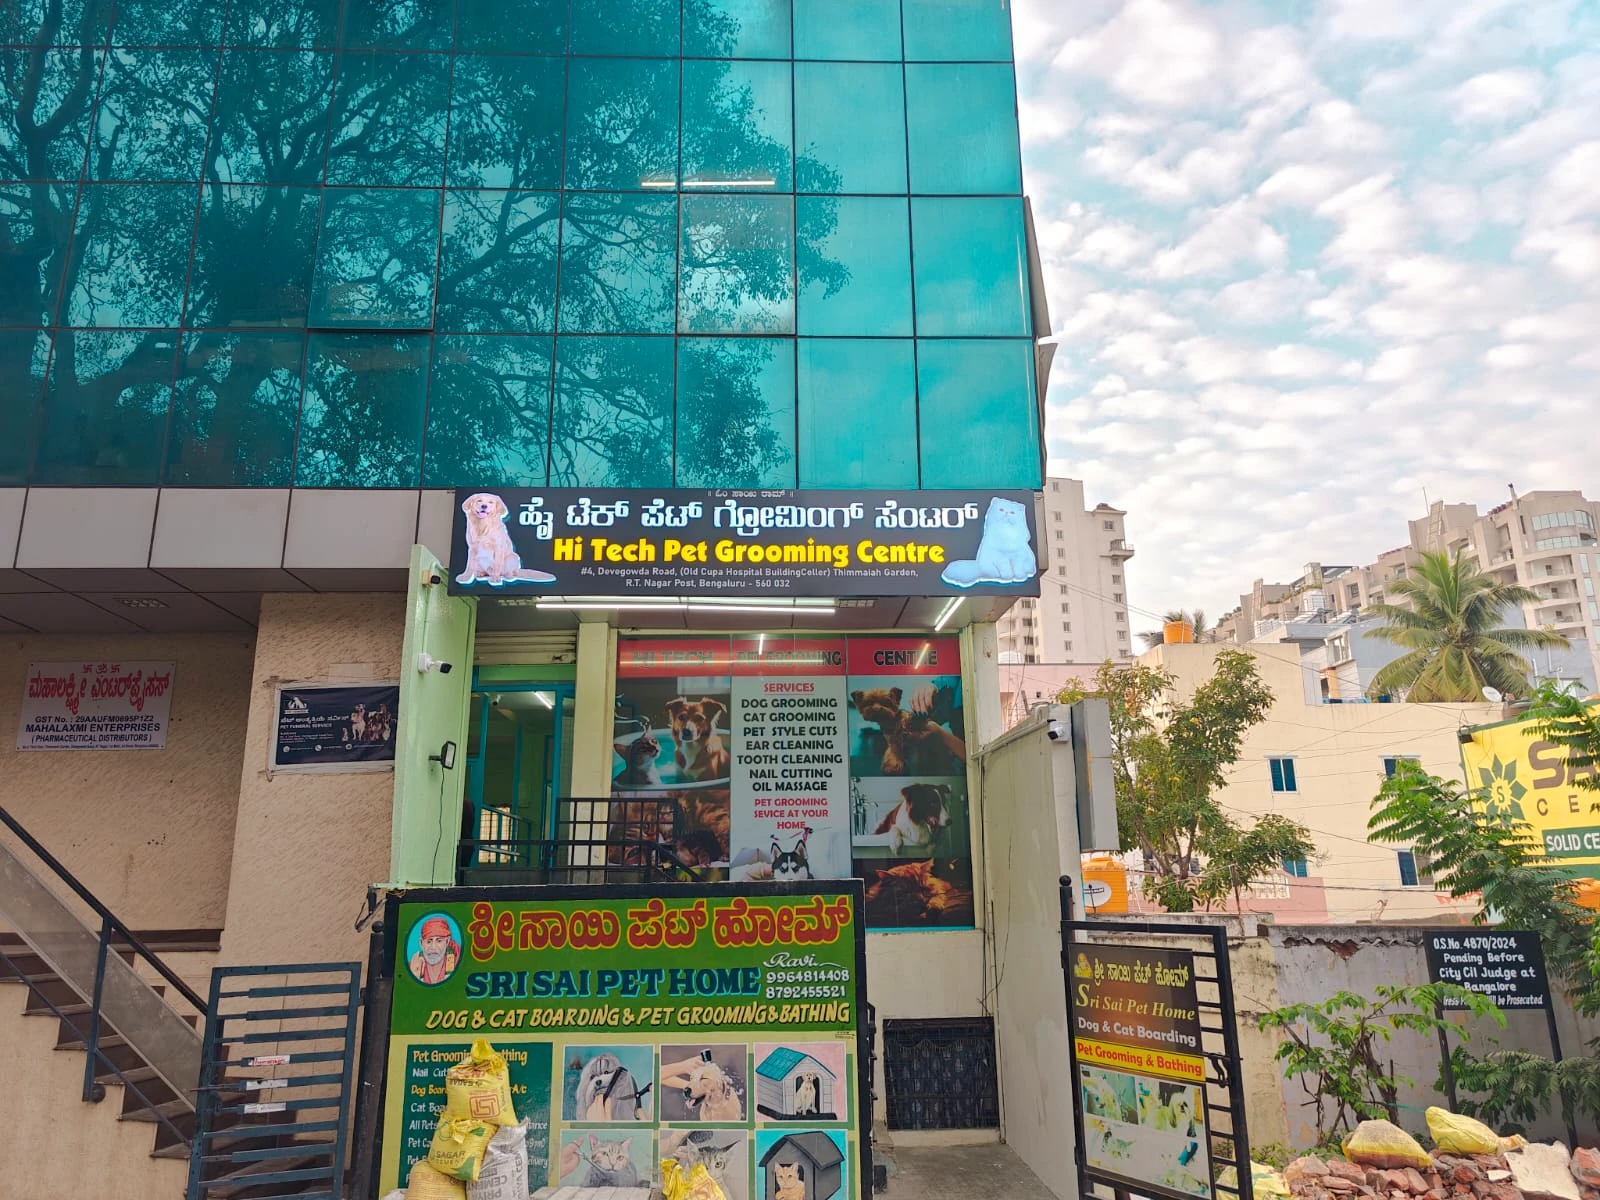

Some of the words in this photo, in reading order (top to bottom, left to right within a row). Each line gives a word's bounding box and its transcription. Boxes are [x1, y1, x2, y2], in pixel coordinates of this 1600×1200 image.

[519, 497, 554, 540] ಹೈ
[566, 497, 630, 527] ಟೆಕ್
[641, 498, 703, 527] ಪೆಟ್
[713, 499, 864, 537] ಗ್ರೋಮಿಂಗ್
[875, 500, 979, 529] ಸೆಂಟರ್
[553, 536, 584, 562] Hi
[590, 538, 656, 562] Tech
[663, 538, 708, 563] Pet
[715, 537, 850, 568] Grooming
[856, 540, 945, 563] Centre
[580, 566, 595, 576] #4,
[598, 566, 650, 578] Devegowda
[652, 566, 678, 577] Road,
[680, 566, 698, 577] (Old
[701, 567, 724, 578] Cupa
[726, 566, 763, 578] Hospital
[833, 567, 881, 577] Thimmaiah
[884, 567, 919, 577] Garden,
[625, 578, 642, 587] R.T.
[644, 578, 672, 588] Nagar
[674, 578, 697, 588] Post,
[699, 578, 746, 589] Bengaluru
[755, 580, 772, 588] 560
[774, 580, 790, 588] 032
[633, 651, 655, 666] HI
[661, 651, 713, 666] TECH
[737, 651, 761, 665] PET
[766, 651, 842, 666] GROOMING
[764, 682, 814, 693] SERVICES
[741, 699, 767, 708] DOG
[771, 698, 838, 708] GROOMING
[744, 713, 766, 722] CAT
[769, 712, 835, 722] GROOMING
[26, 724, 88, 732] MAHALAXMI
[90, 723, 161, 732] ENTERPRISES
[744, 727, 765, 736] PET
[772, 727, 806, 736] STYLE
[809, 726, 837, 736] CUTS
[99, 734, 148, 742] DISTRIBUTORS
[746, 741, 769, 750] EAR
[773, 740, 833, 750] CLEANING
[737, 755, 778, 764] TOOTH
[782, 754, 842, 764] CLEANING
[749, 769, 778, 778] NAIL
[781, 769, 832, 778] CUTTING
[752, 782, 772, 791] OIL
[775, 782, 827, 791] MASSAGE
[754, 799, 772, 807] PET
[774, 798, 828, 806] GROOMING
[754, 810, 785, 818] SEVICE
[802, 809, 829, 817] YOUR
[777, 821, 806, 829] HOME
[1546, 834, 1581, 852] SOLID
[467, 901, 515, 962] ಶ್ರೀ
[519, 909, 621, 951] ಸಾಯಿ
[627, 898, 707, 949] ಪೆಟ್
[712, 895, 851, 948] ಹೋಮ್
[1463, 936, 1517, 951] 4870/2024
[1443, 952, 1483, 965] Pending
[1487, 952, 1525, 963] Before
[766, 970, 850, 984] 9964814408
[1094, 958, 1105, 986] ಶ್ರೀ
[1107, 963, 1131, 982] ಸಾಯಿ
[1133, 960, 1152, 984] ಪೆಟ್
[1155, 961, 1189, 988] ಹೋಮ್
[1439, 967, 1461, 980] City
[1481, 967, 1517, 980] Judge
[1521, 967, 1536, 977] at
[465, 970, 529, 999] SRI
[532, 969, 591, 999] SAI
[596, 967, 665, 998] PET
[668, 967, 762, 996] HOME
[1464, 981, 1517, 995] Bangalore
[766, 986, 847, 1000] 8792455521
[1076, 983, 1100, 1008] Sri
[1102, 996, 1123, 1012] Sai
[1126, 998, 1148, 1015] Pet
[1152, 1000, 1196, 1021] Home
[1497, 996, 1505, 1005] be
[1506, 994, 1543, 1005] Prosecuted
[425, 1010, 468, 1030] DOG
[471, 1010, 487, 1029] &
[489, 1009, 528, 1029] CAT
[529, 1004, 620, 1027] BOARDING
[636, 1007, 676, 1025] PET
[676, 1001, 767, 1026] GROOMING
[778, 1000, 850, 1024] BATHING
[1078, 1017, 1100, 1033] Dog
[1102, 1020, 1112, 1033] &
[1113, 1022, 1135, 1037] Cat
[1137, 1025, 1197, 1048] Boarding
[413, 1050, 430, 1063] Pet
[1077, 1042, 1093, 1056] Pet
[1095, 1045, 1143, 1067] Grooming
[1145, 1053, 1154, 1067] &
[1156, 1056, 1203, 1077] Bathing
[412, 1068, 429, 1077] Nail
[411, 1085, 426, 1097] Dog
[410, 1103, 426, 1113] Cat
[409, 1120, 420, 1130] All
[408, 1138, 421, 1148] Pet
